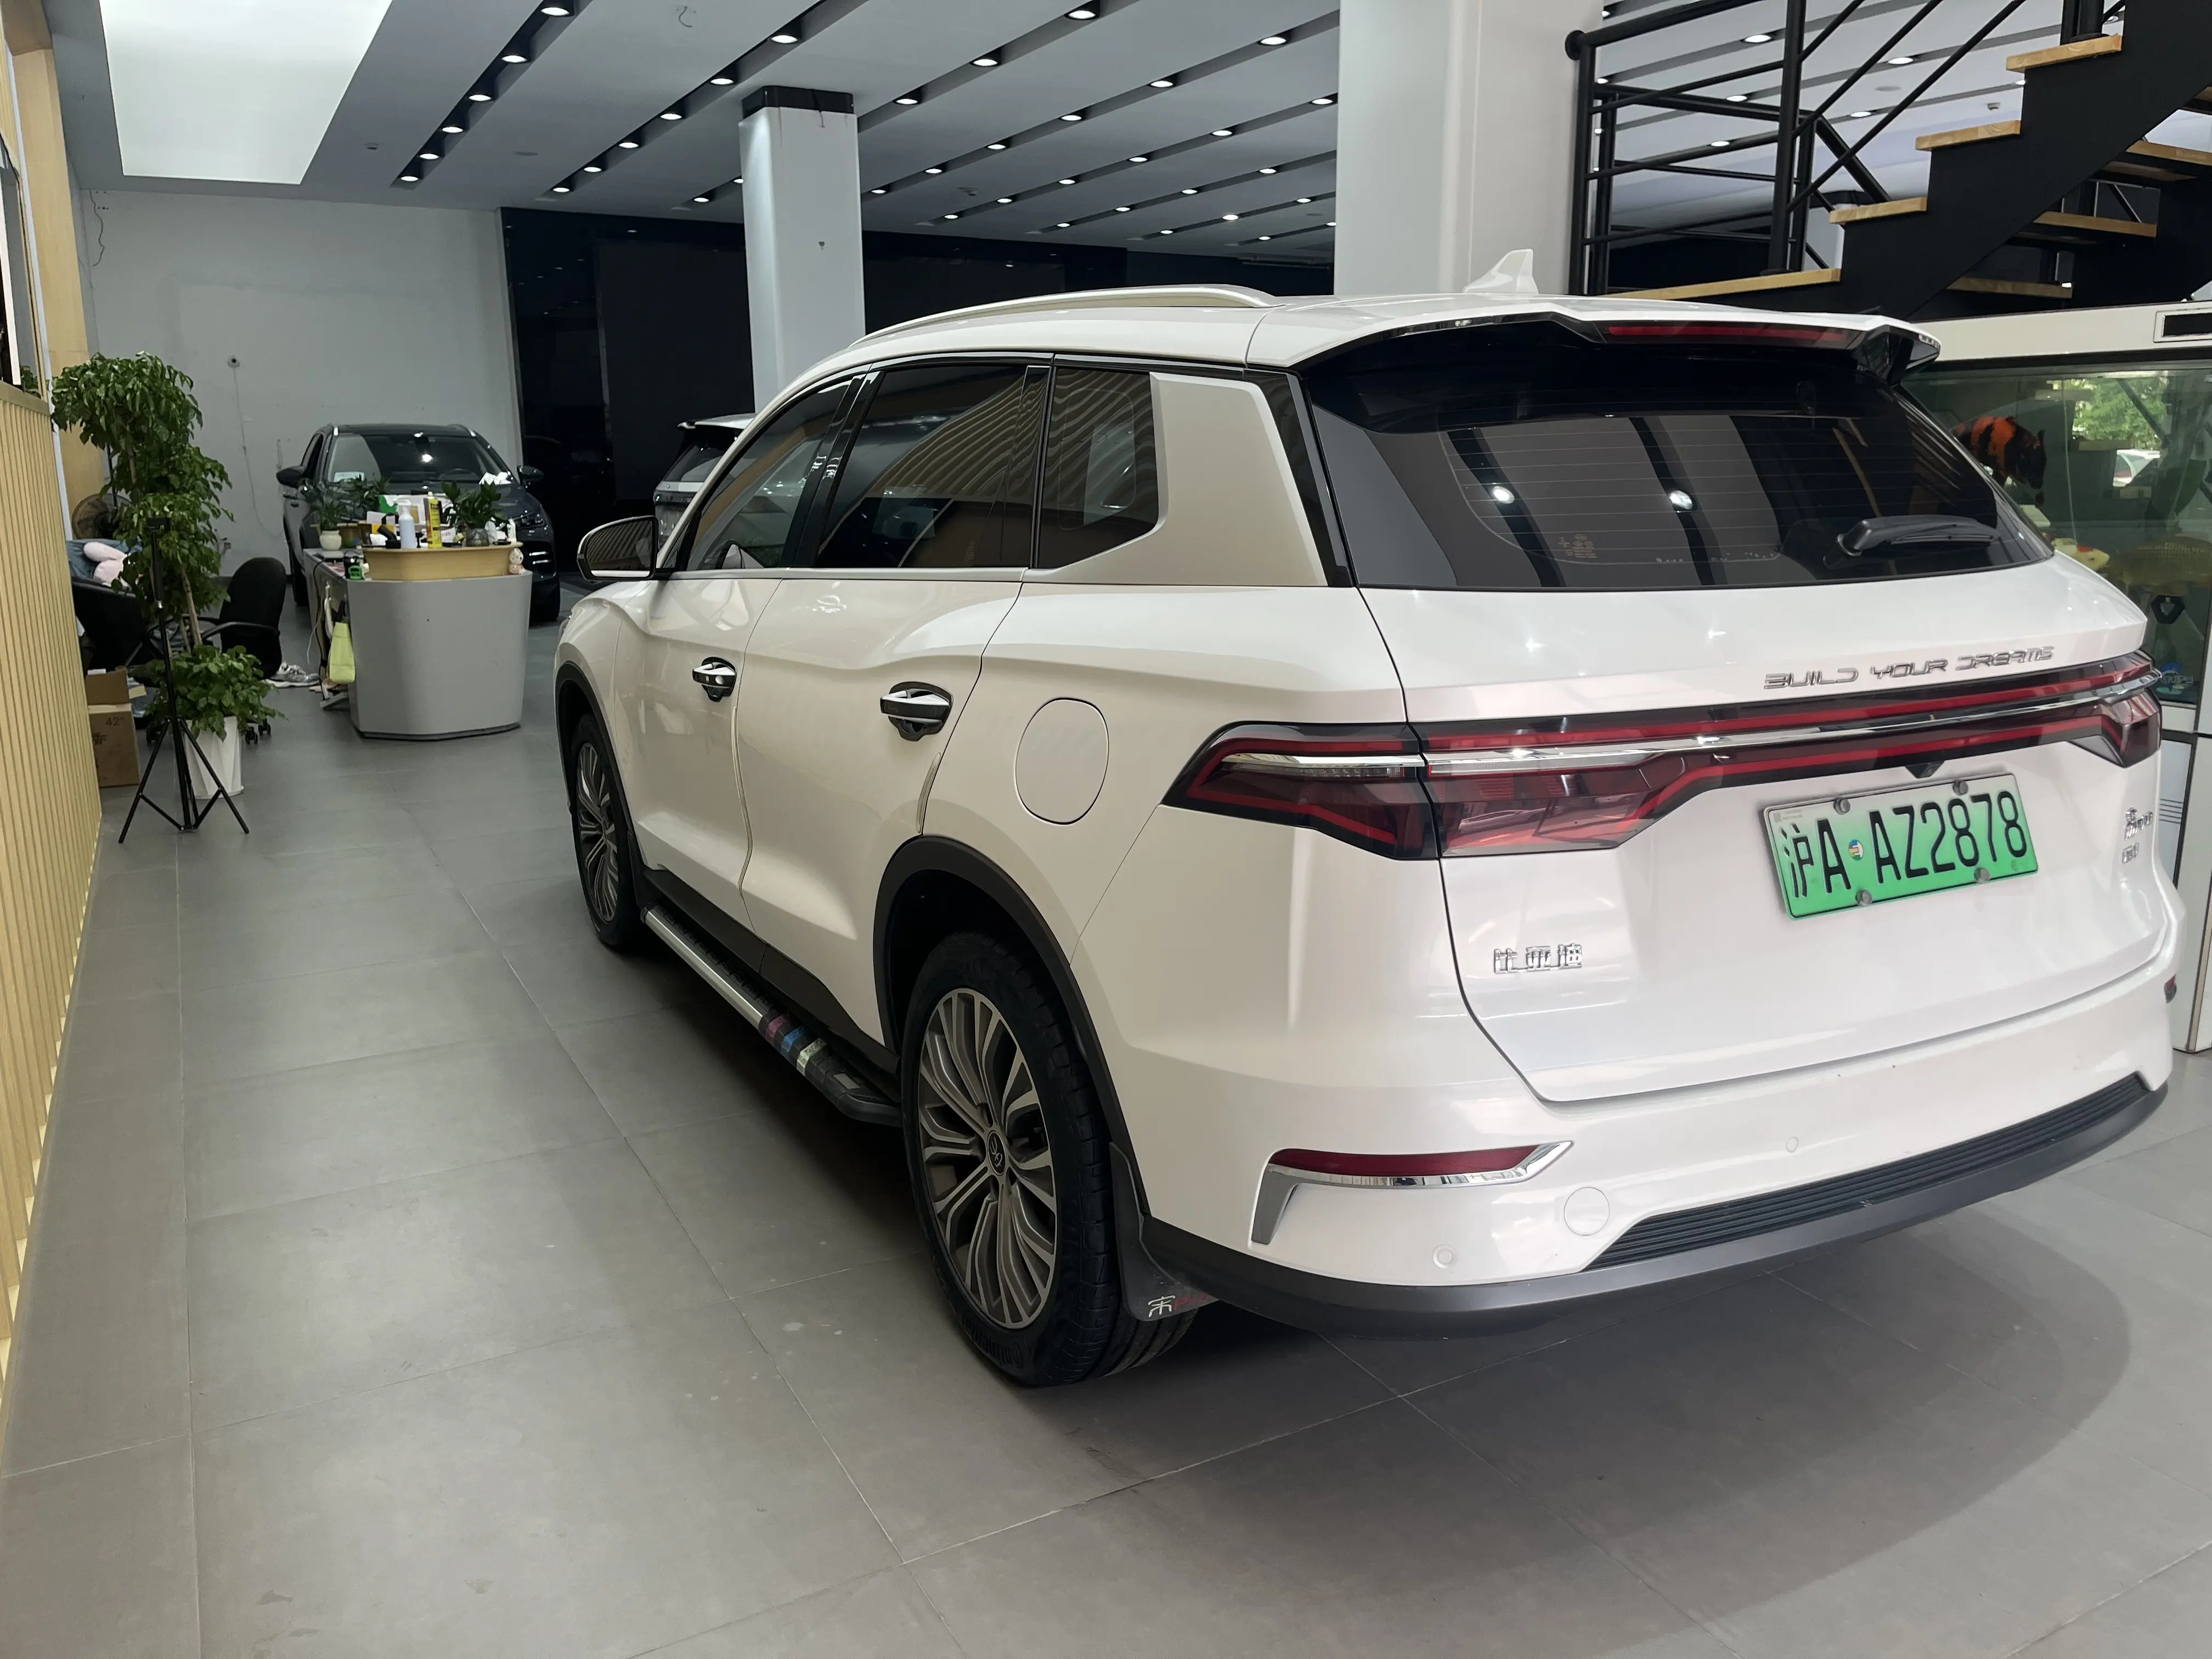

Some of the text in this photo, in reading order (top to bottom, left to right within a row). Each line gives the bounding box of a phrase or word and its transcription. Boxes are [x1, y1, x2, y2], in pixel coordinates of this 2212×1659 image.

[1764, 646, 2055, 690] BUILD YOUR DREAMS
[1868, 790, 2028, 884] AZ2878
[1493, 943, 1583, 975] 比亚迪
